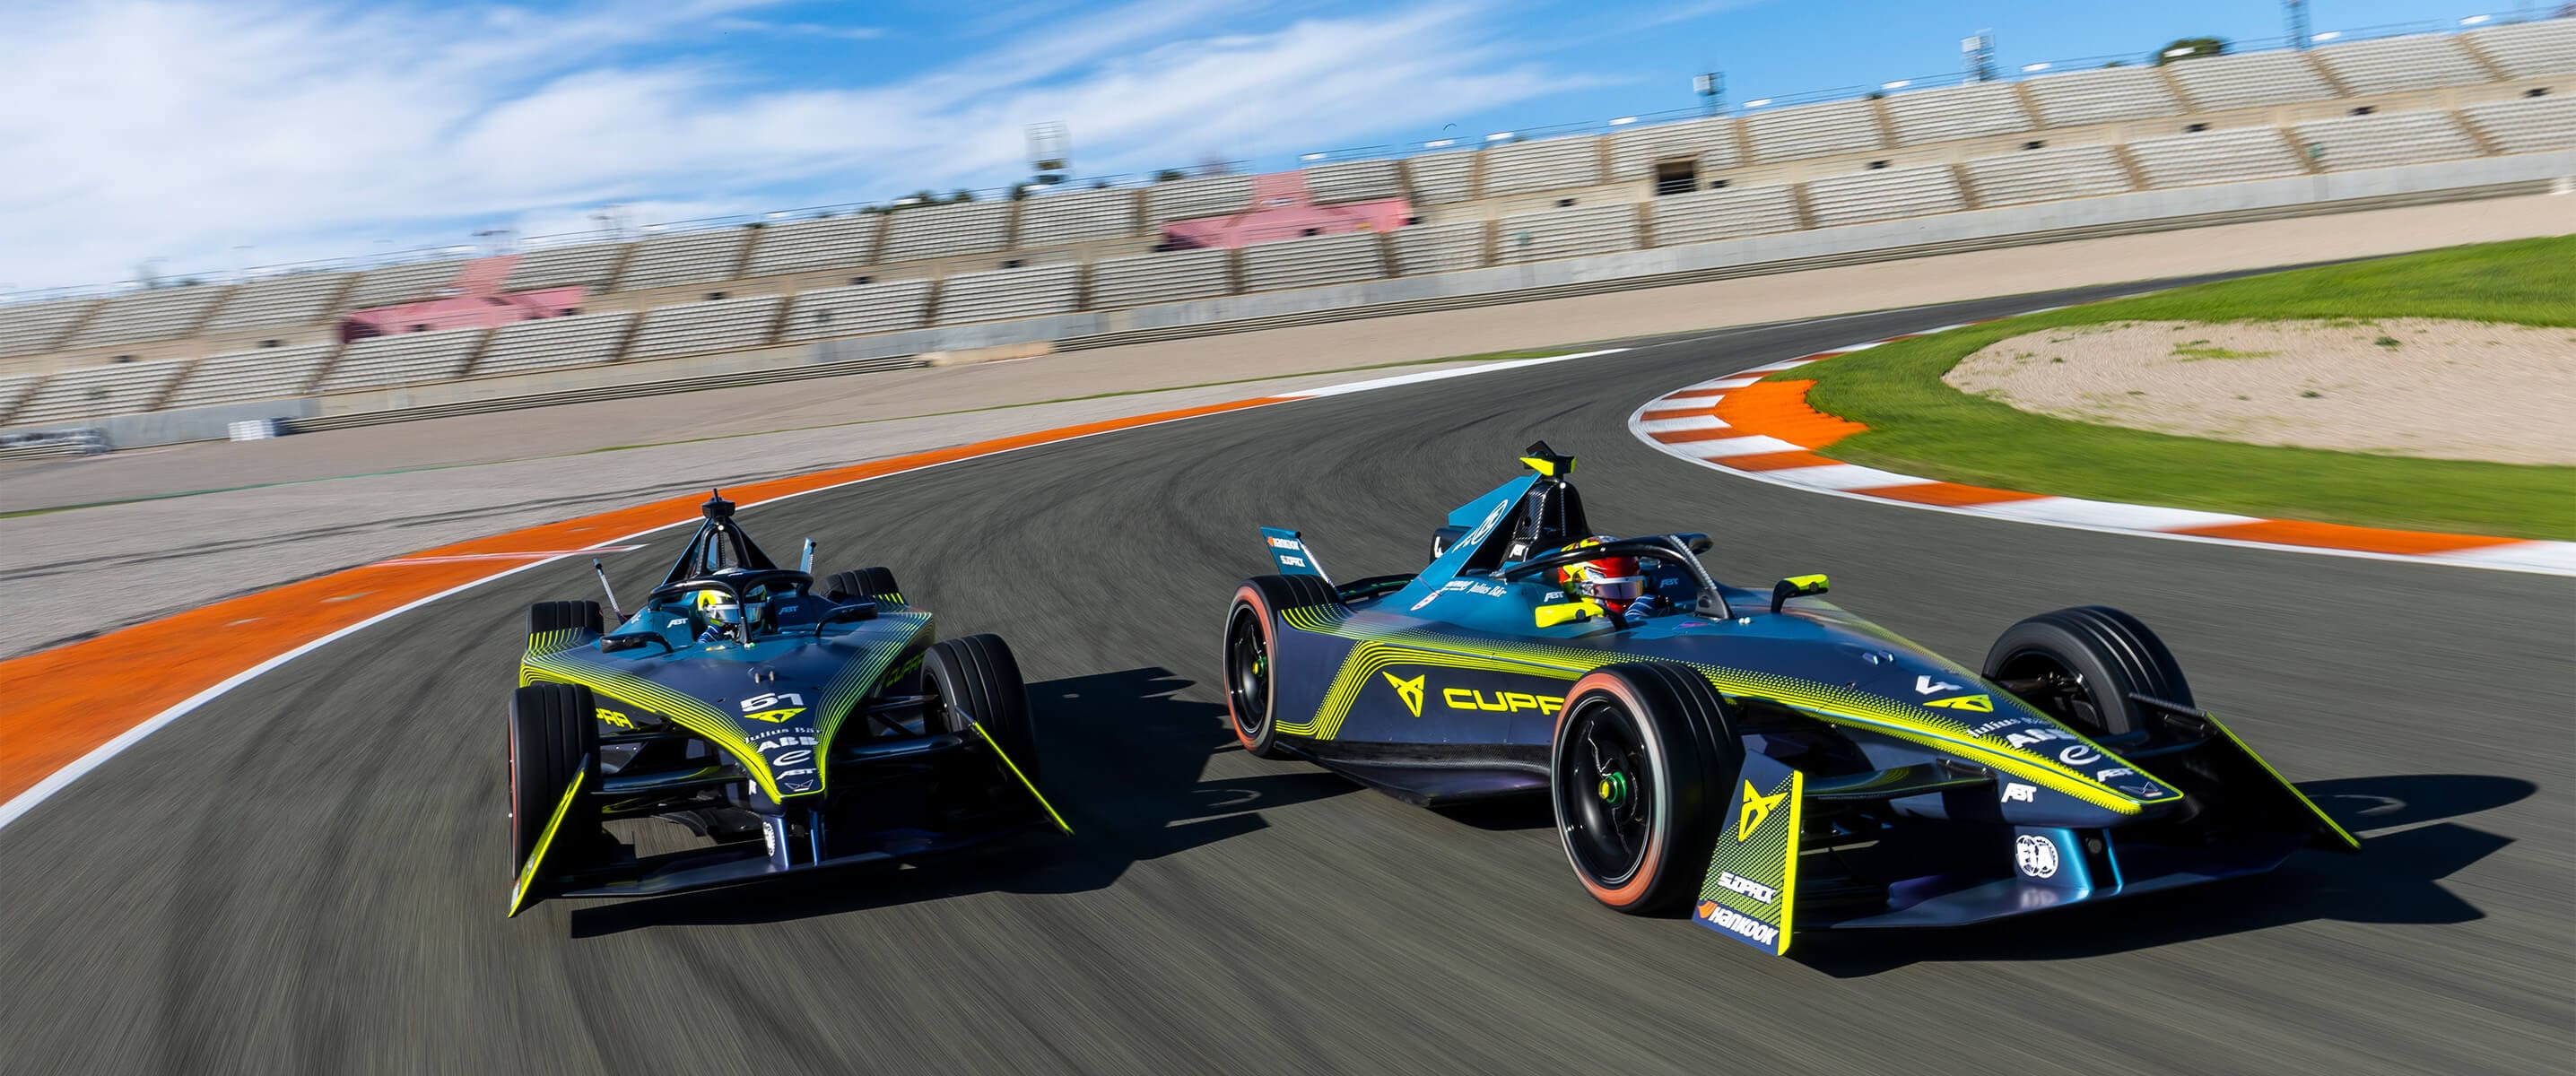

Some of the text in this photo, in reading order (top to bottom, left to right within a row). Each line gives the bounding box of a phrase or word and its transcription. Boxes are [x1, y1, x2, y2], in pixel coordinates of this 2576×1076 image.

[1544, 591, 1565, 603] ABT
[666, 617, 689, 629] ABT
[1915, 674, 1962, 695] 4
[740, 692, 804, 712] 51
[1442, 687, 1565, 716] CUPR
[756, 736, 820, 754] ABB
[2000, 782, 2038, 803] ABT
[2017, 841, 2055, 873] FIA
